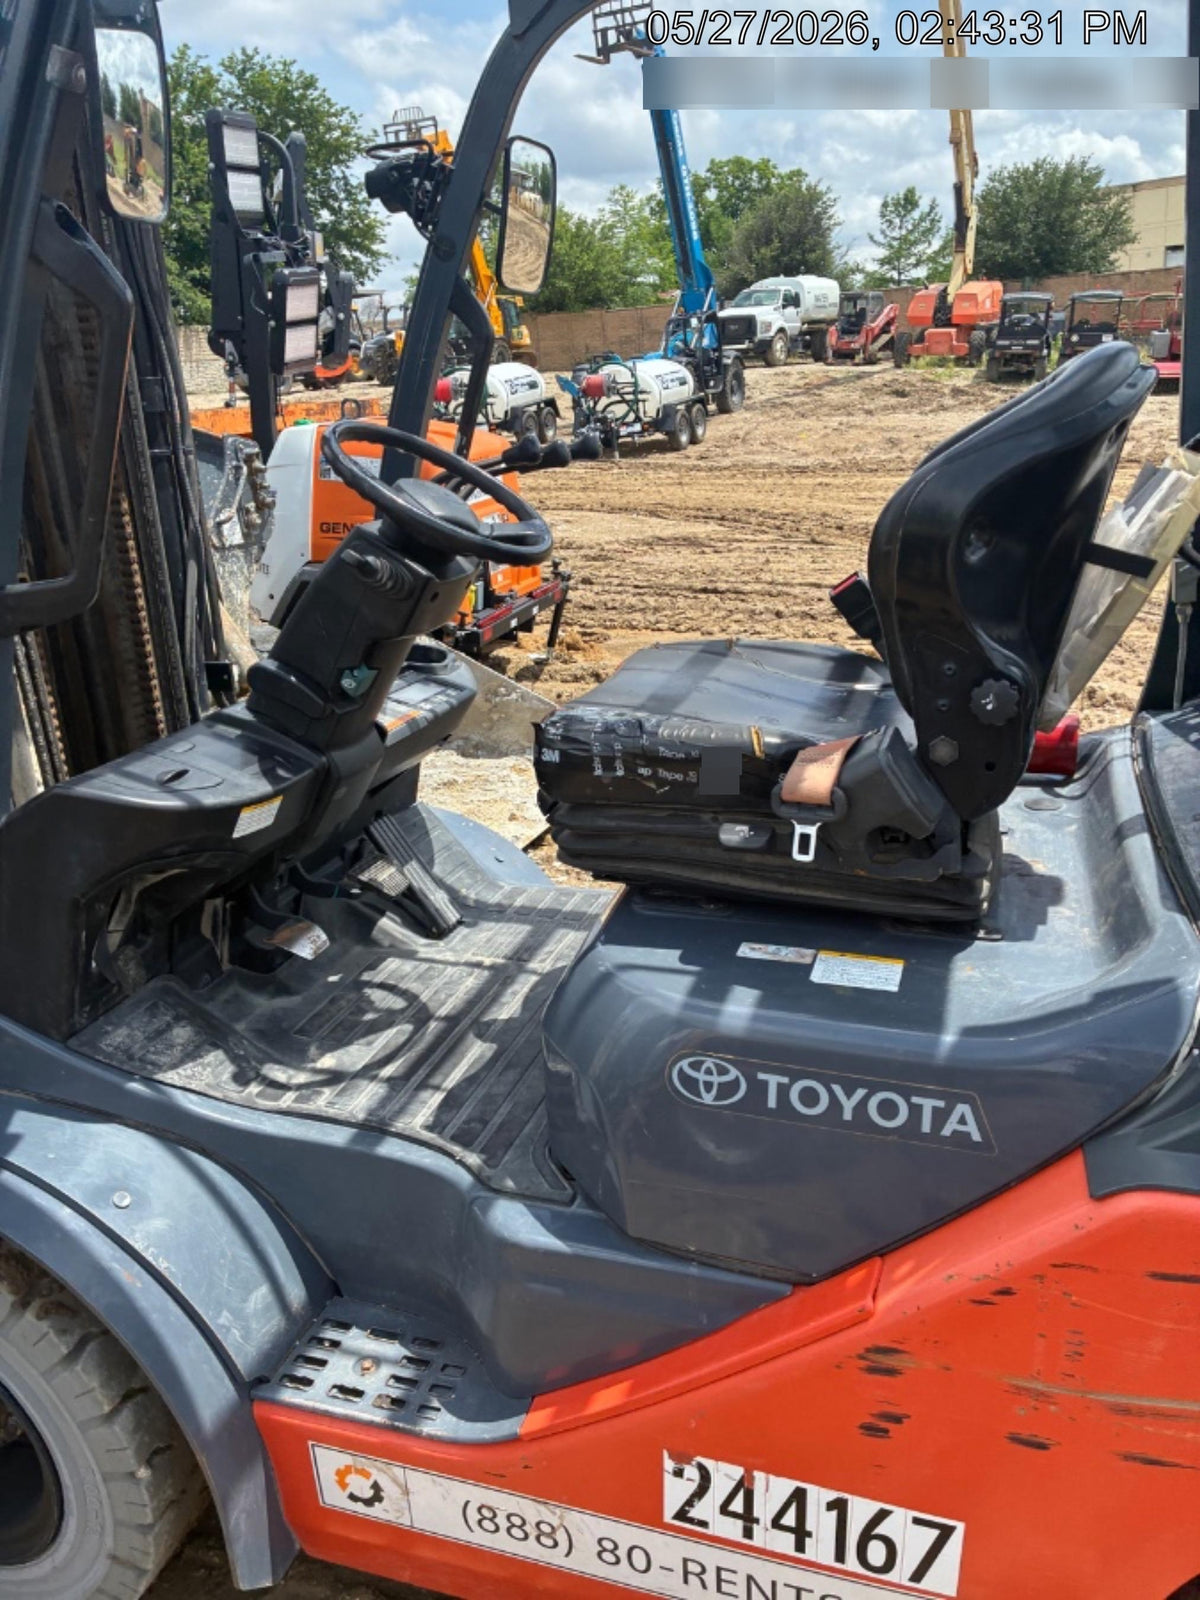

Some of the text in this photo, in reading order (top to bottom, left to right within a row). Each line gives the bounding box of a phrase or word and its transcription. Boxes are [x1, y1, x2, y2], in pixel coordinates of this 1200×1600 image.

[541, 748, 560, 763] 3M
[757, 1072, 982, 1142] TOYOTA
[461, 1499, 844, 1600] (888) 80-RENT
[671, 1459, 957, 1584] 244167
